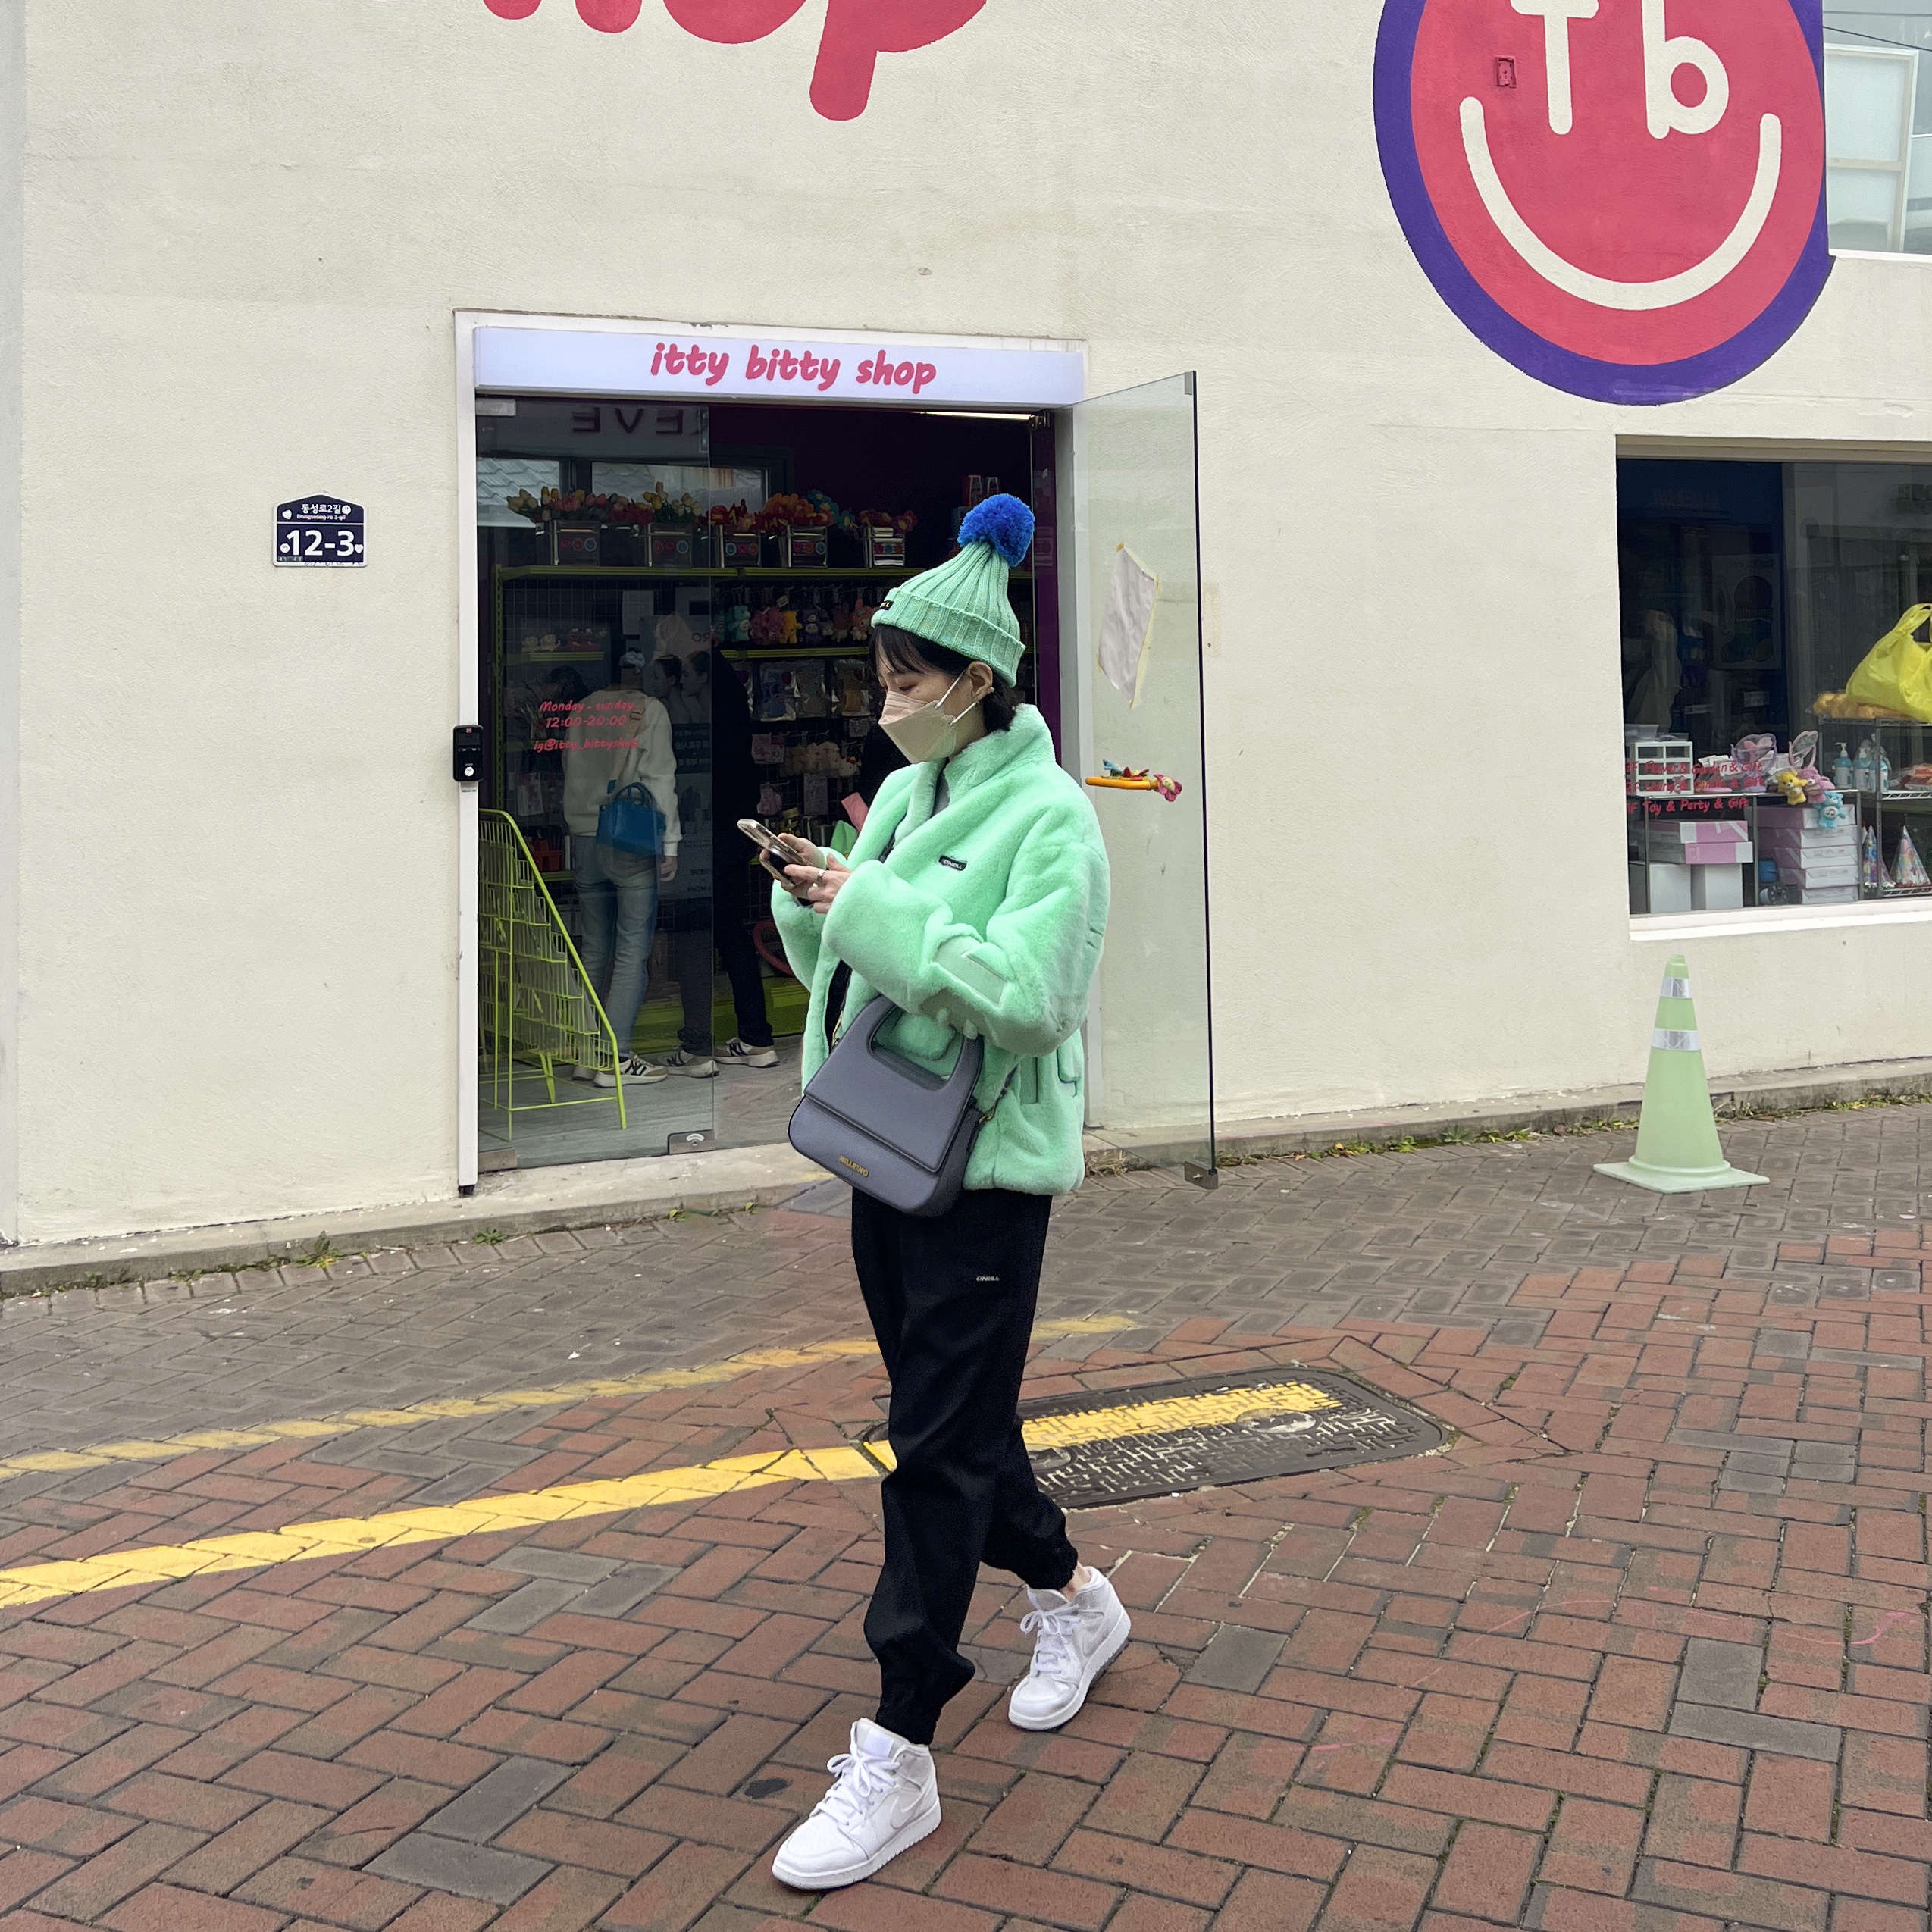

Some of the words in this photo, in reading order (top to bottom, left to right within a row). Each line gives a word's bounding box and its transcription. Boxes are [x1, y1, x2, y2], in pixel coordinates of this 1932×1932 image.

[650, 342, 730, 387] itty
[745, 344, 841, 391] bitty
[856, 349, 937, 394] shop
[301, 504, 341, 514] 동성로2길
[286, 529, 355, 557] 12-3
[538, 700, 585, 713] Monday
[1729, 760, 1739, 772] &
[1642, 800, 1662, 816] Toy
[1665, 800, 1676, 812] &
[1680, 798, 1711, 813] Party
[1713, 797, 1724, 809] &
[1727, 796, 1750, 809] Gift
